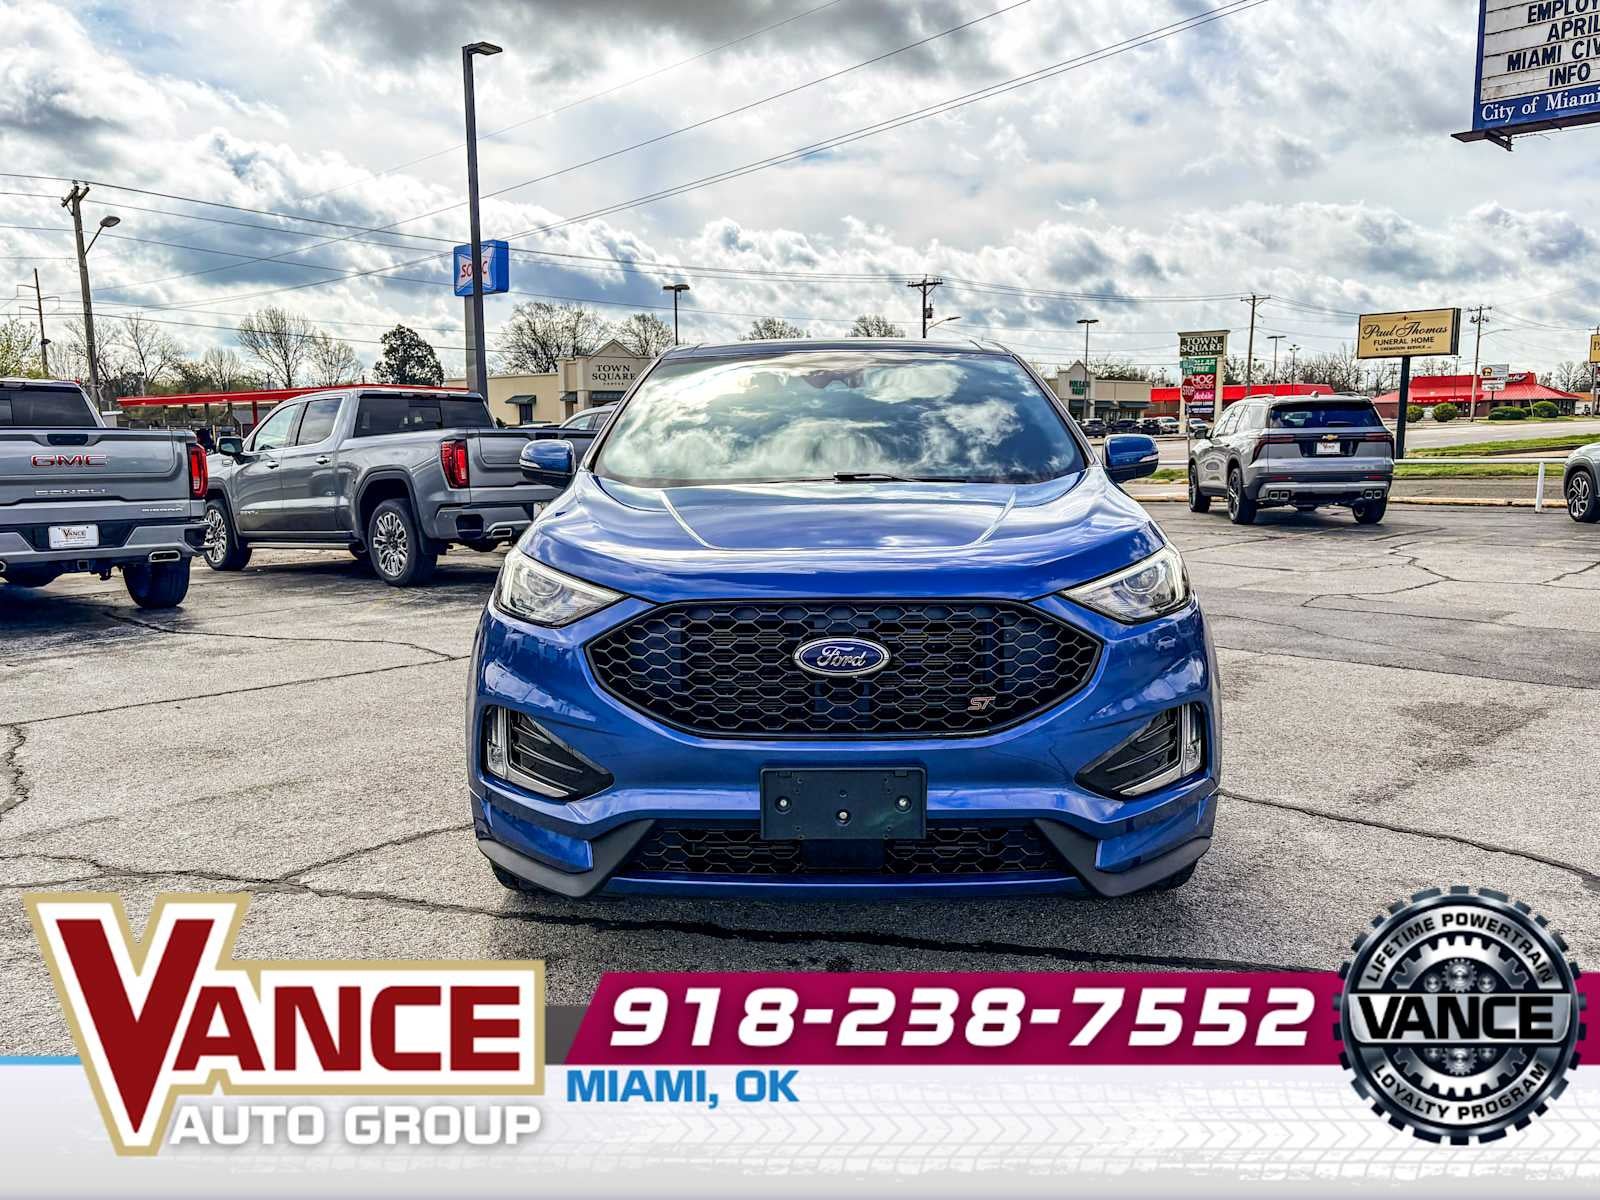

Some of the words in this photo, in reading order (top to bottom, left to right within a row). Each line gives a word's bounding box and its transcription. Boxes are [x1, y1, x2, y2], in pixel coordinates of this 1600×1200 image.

[1547, 14, 1600, 42] APRIL
[1507, 44, 1562, 72] MIAMI
[1549, 62, 1591, 87] INFO
[1481, 104, 1516, 122] City
[1521, 97, 1539, 115] of
[461, 260, 488, 278] SOC
[1361, 324, 1397, 340] Paul
[1395, 321, 1448, 338] Thomas
[1180, 342, 1223, 353] SQUARE
[1185, 336, 1219, 345] TOWN
[1373, 337, 1408, 346] FUNERAL
[1410, 336, 1435, 344] HOME
[595, 364, 631, 372] TOWN
[592, 373, 637, 381] SQUARE
[1182, 386, 1196, 396] STOP
[31, 454, 107, 467] GMC
[816, 645, 867, 667] Ford
[968, 696, 996, 711] ST
